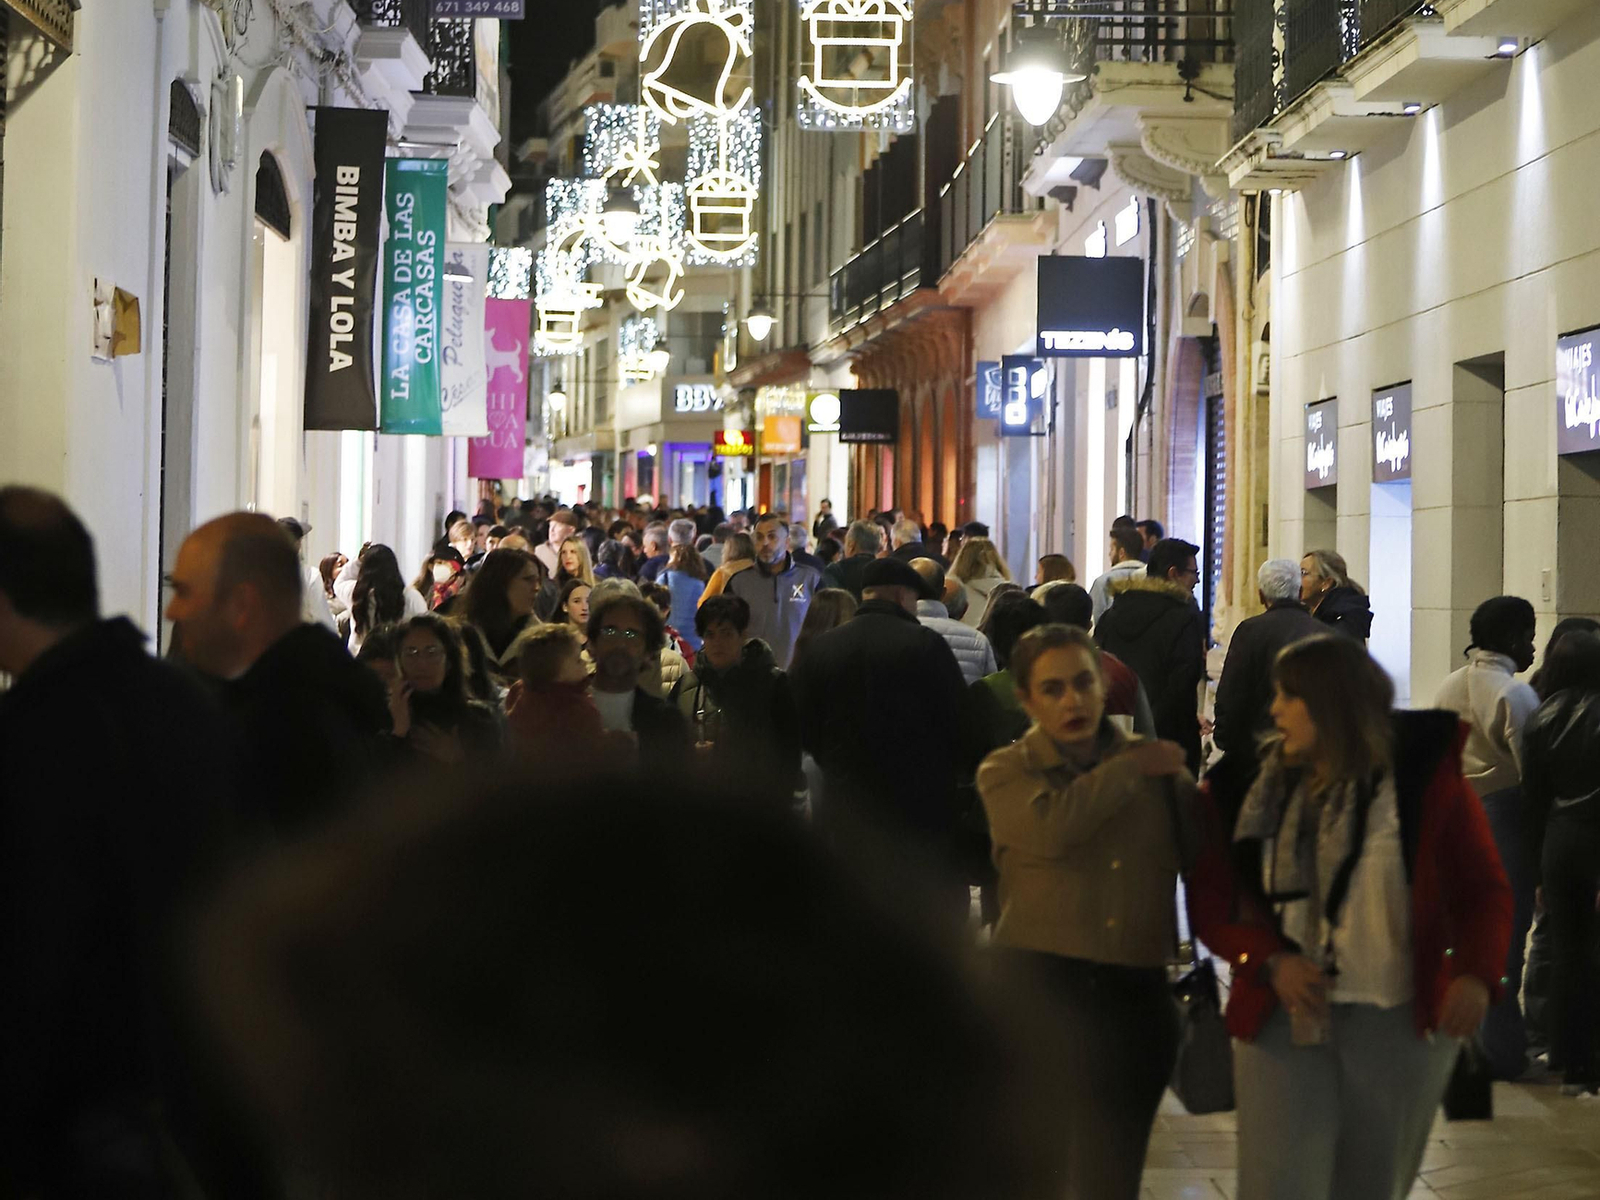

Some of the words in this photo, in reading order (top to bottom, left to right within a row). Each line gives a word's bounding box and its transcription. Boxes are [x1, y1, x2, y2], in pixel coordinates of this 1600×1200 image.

[436, 1, 459, 13] 671
[465, 1, 490, 13] 349
[494, 1, 520, 13] 468
[332, 165, 360, 263] BIMBA
[395, 192, 415, 241] LAS
[331, 268, 355, 289] Y
[394, 249, 412, 284] DE
[414, 229, 437, 366] CARCASAS
[329, 297, 355, 373] LOLA
[392, 288, 412, 357] CASA
[391, 366, 410, 401] LA
